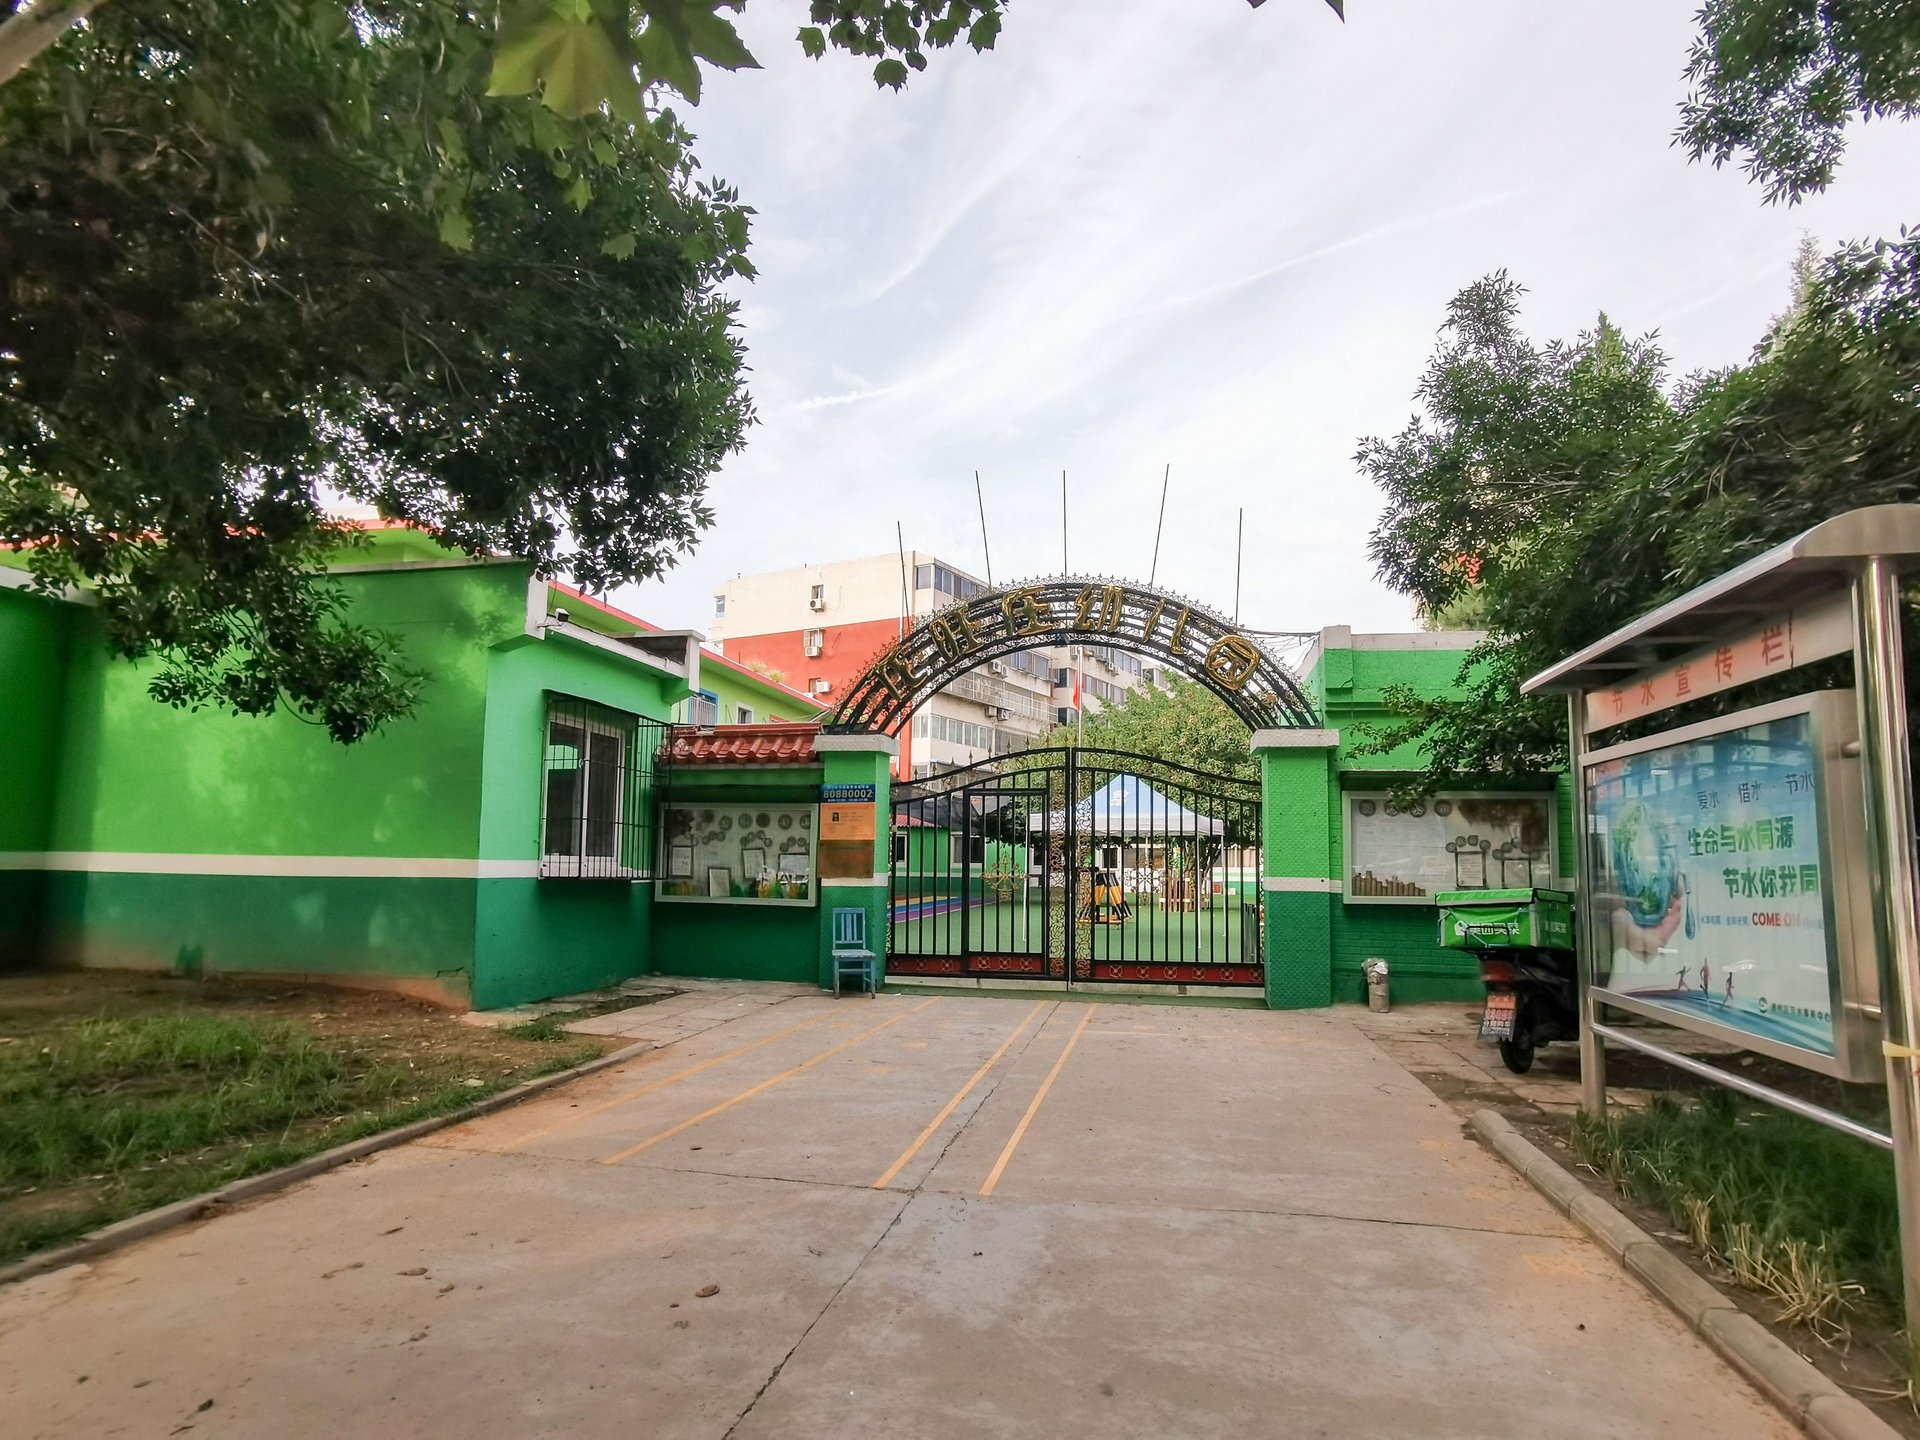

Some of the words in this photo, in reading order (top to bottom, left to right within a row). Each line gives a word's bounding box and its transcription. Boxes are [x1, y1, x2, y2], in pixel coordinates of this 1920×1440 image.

[1612, 624, 1784, 716] 节水宣传栏
[823, 789, 873, 798] 80880002
[1738, 780, 1763, 803] 惜水
[1784, 770, 1815, 795] 节水
[1688, 816, 1794, 856] 生命与水同源
[1752, 912, 1781, 927] COME
